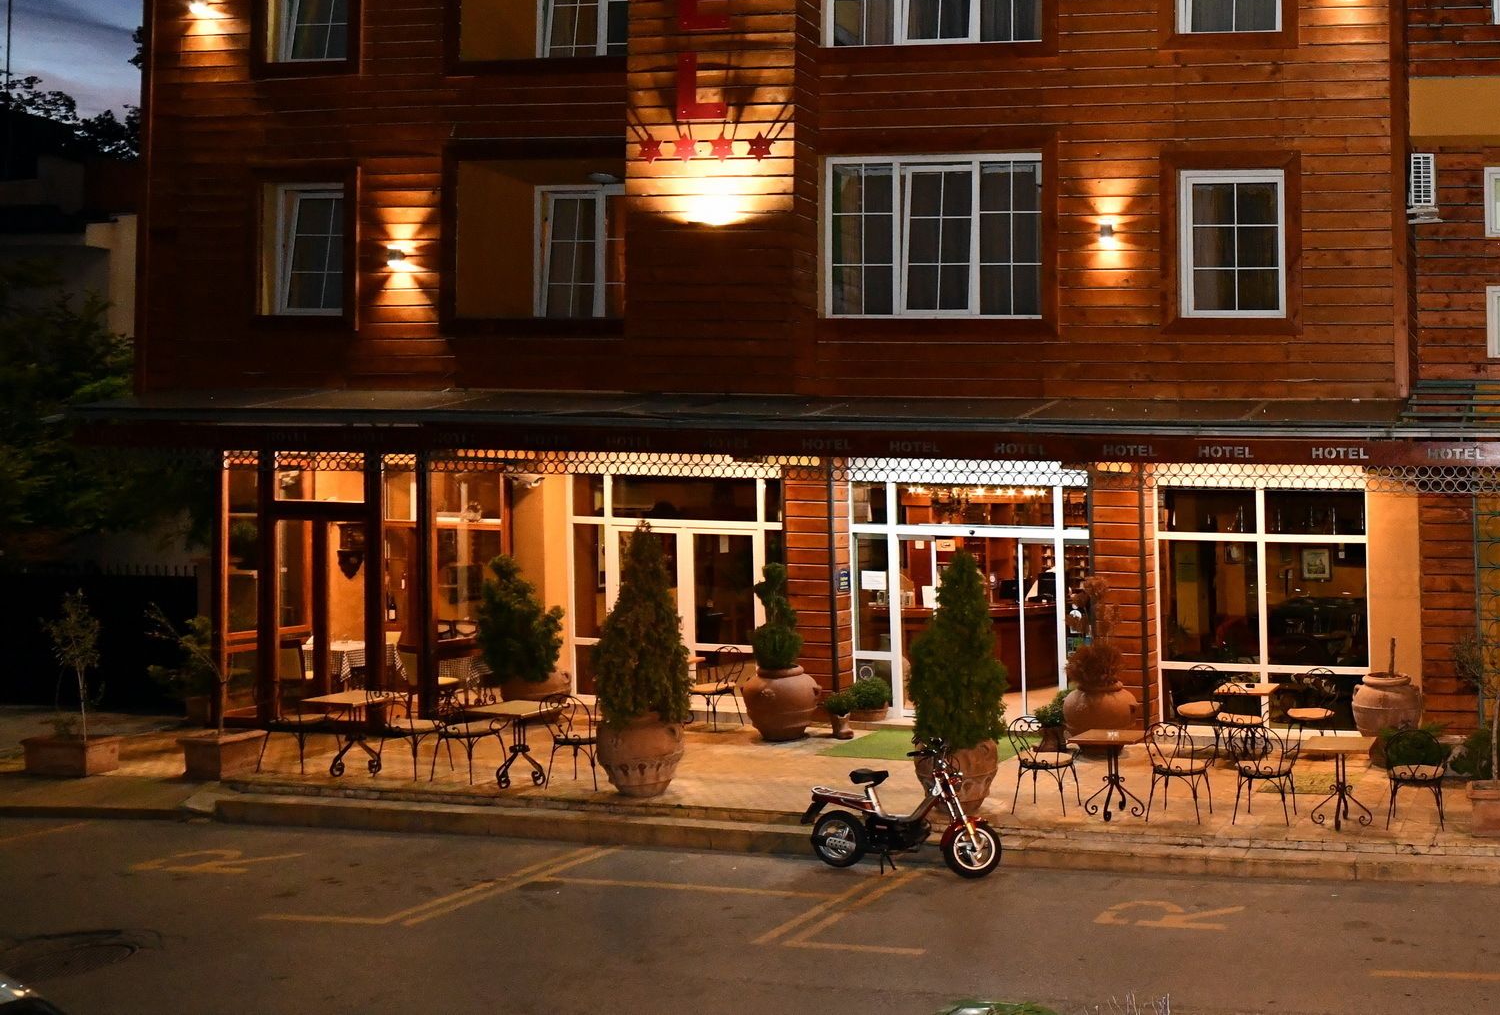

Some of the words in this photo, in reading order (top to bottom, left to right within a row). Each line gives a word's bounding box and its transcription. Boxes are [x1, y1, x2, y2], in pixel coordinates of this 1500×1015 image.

[801, 438, 850, 450] HOTEL
[889, 440, 940, 453] HOTEL
[993, 443, 1047, 455] HOTEL
[1103, 445, 1158, 457] HOTEL
[1198, 446, 1254, 458] HOTEL
[1311, 447, 1369, 460] HOTEL
[1426, 447, 1485, 460] HOTEL
